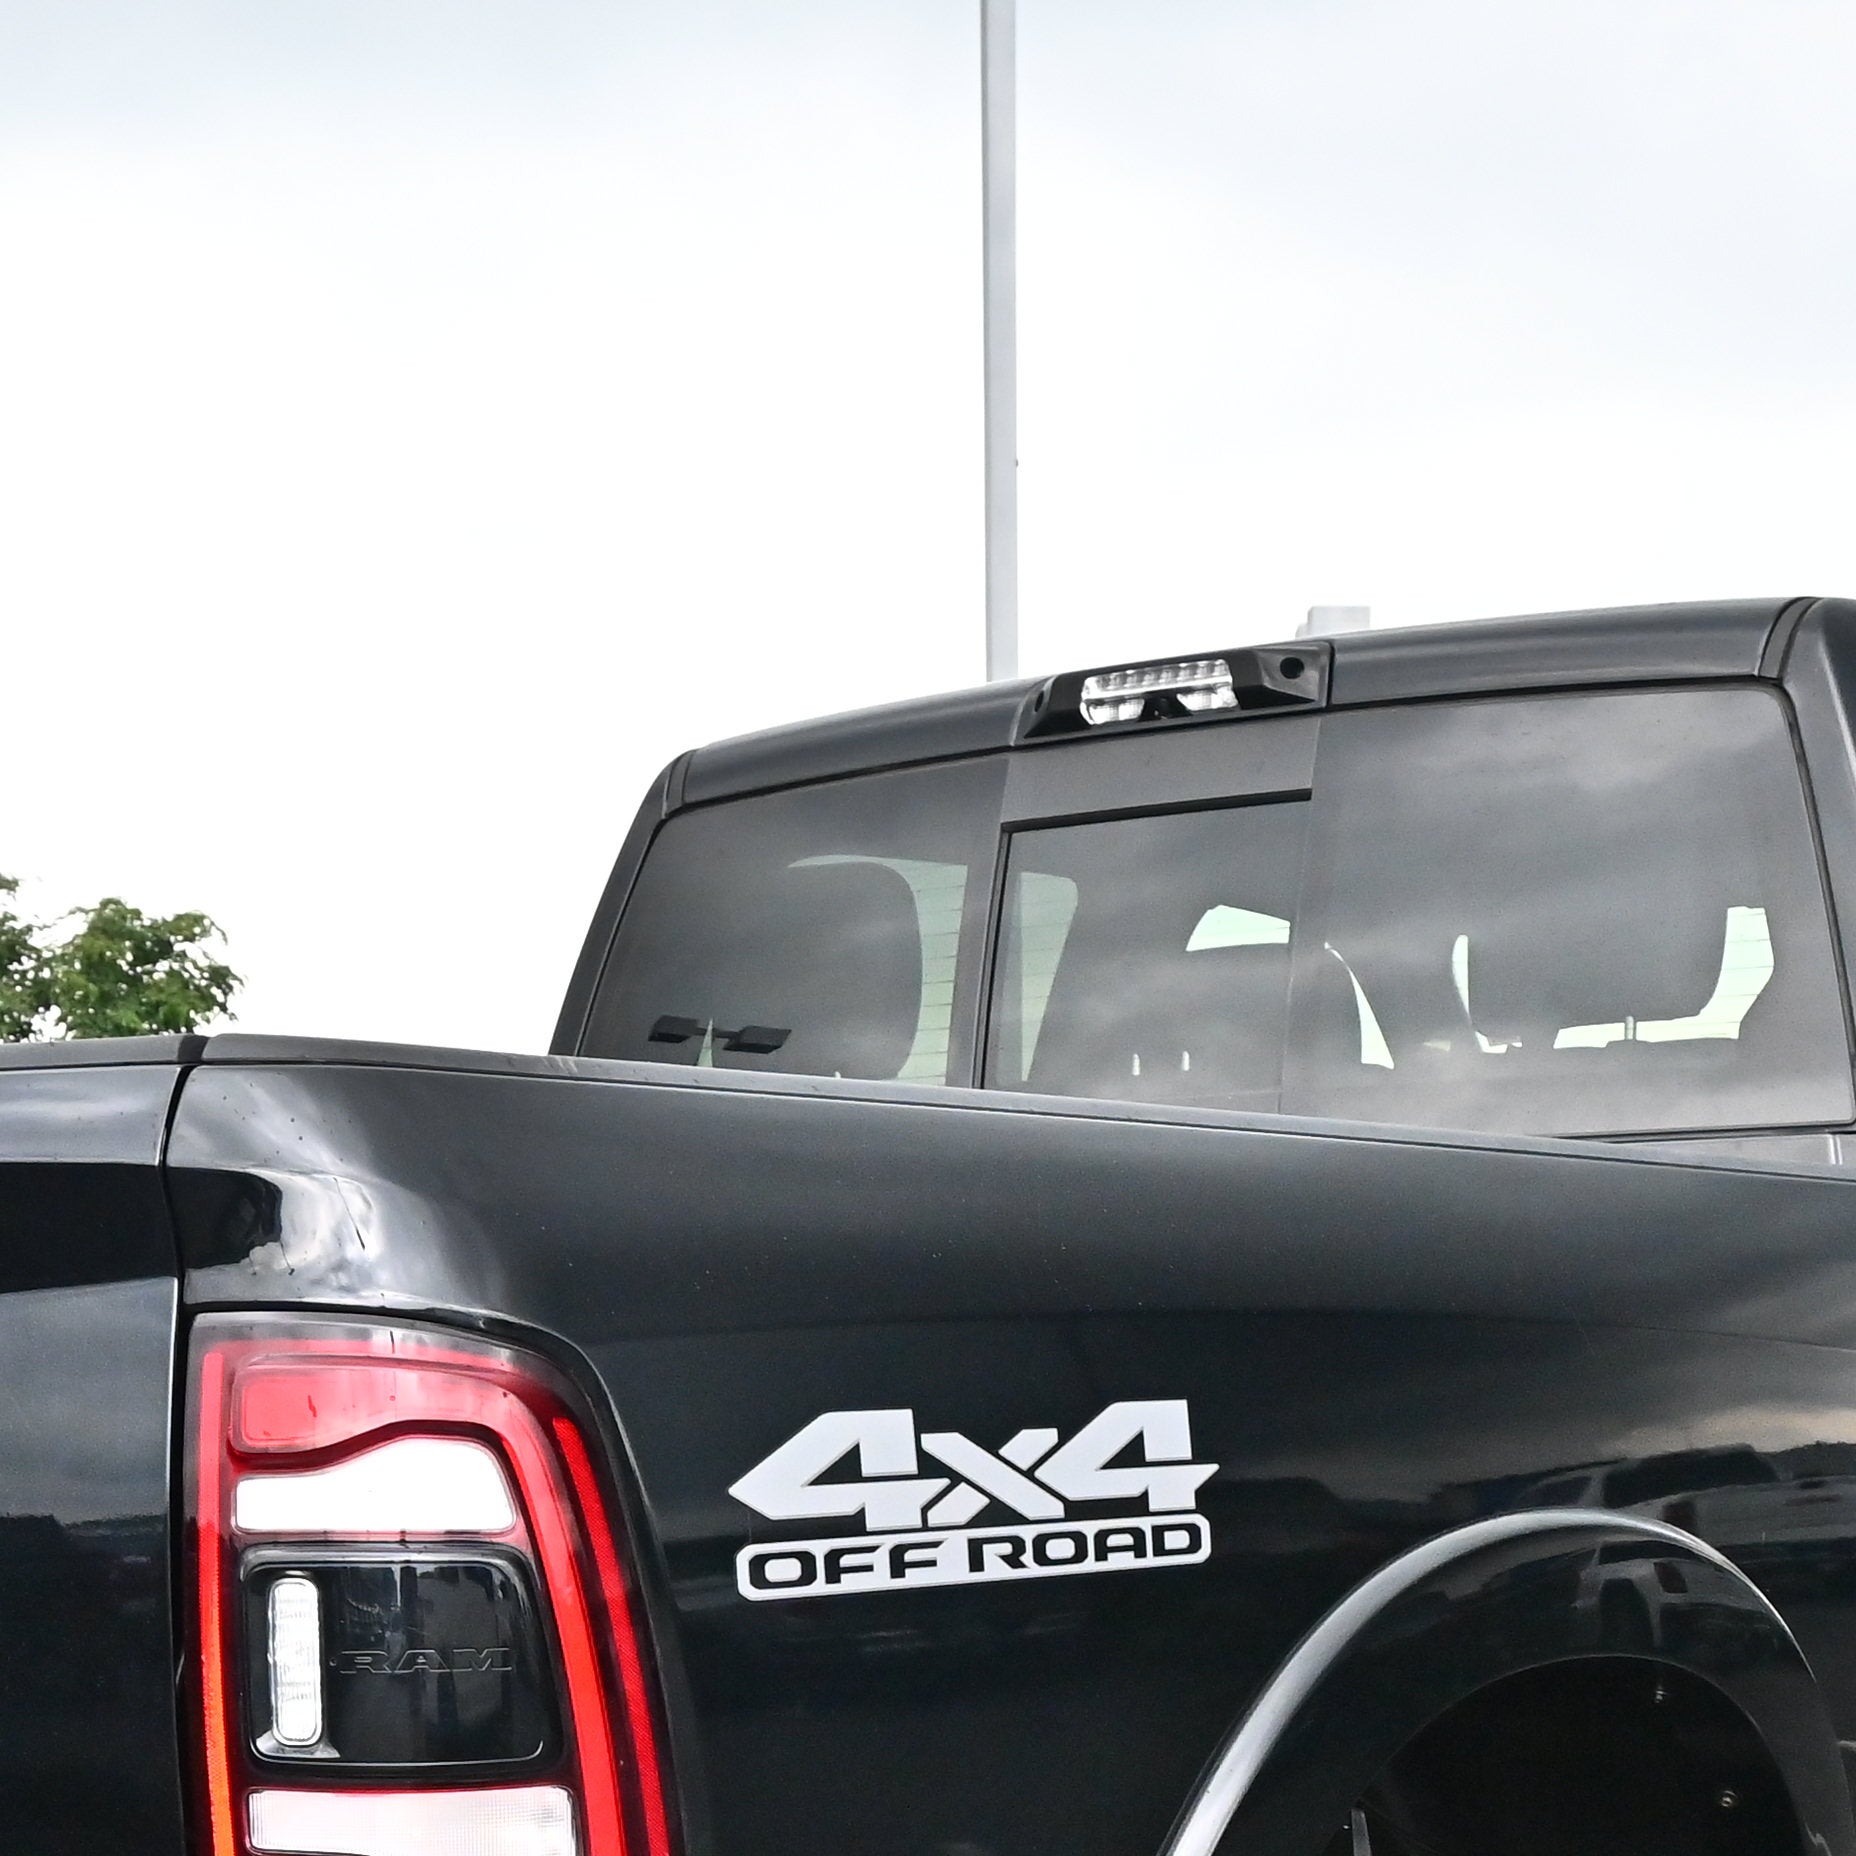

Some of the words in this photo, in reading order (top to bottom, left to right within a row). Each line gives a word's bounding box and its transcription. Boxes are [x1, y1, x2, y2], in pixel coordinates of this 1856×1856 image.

[747, 1537, 949, 1591] OFF
[968, 1522, 1204, 1574] ROAD
[335, 1647, 515, 1674] RAM
